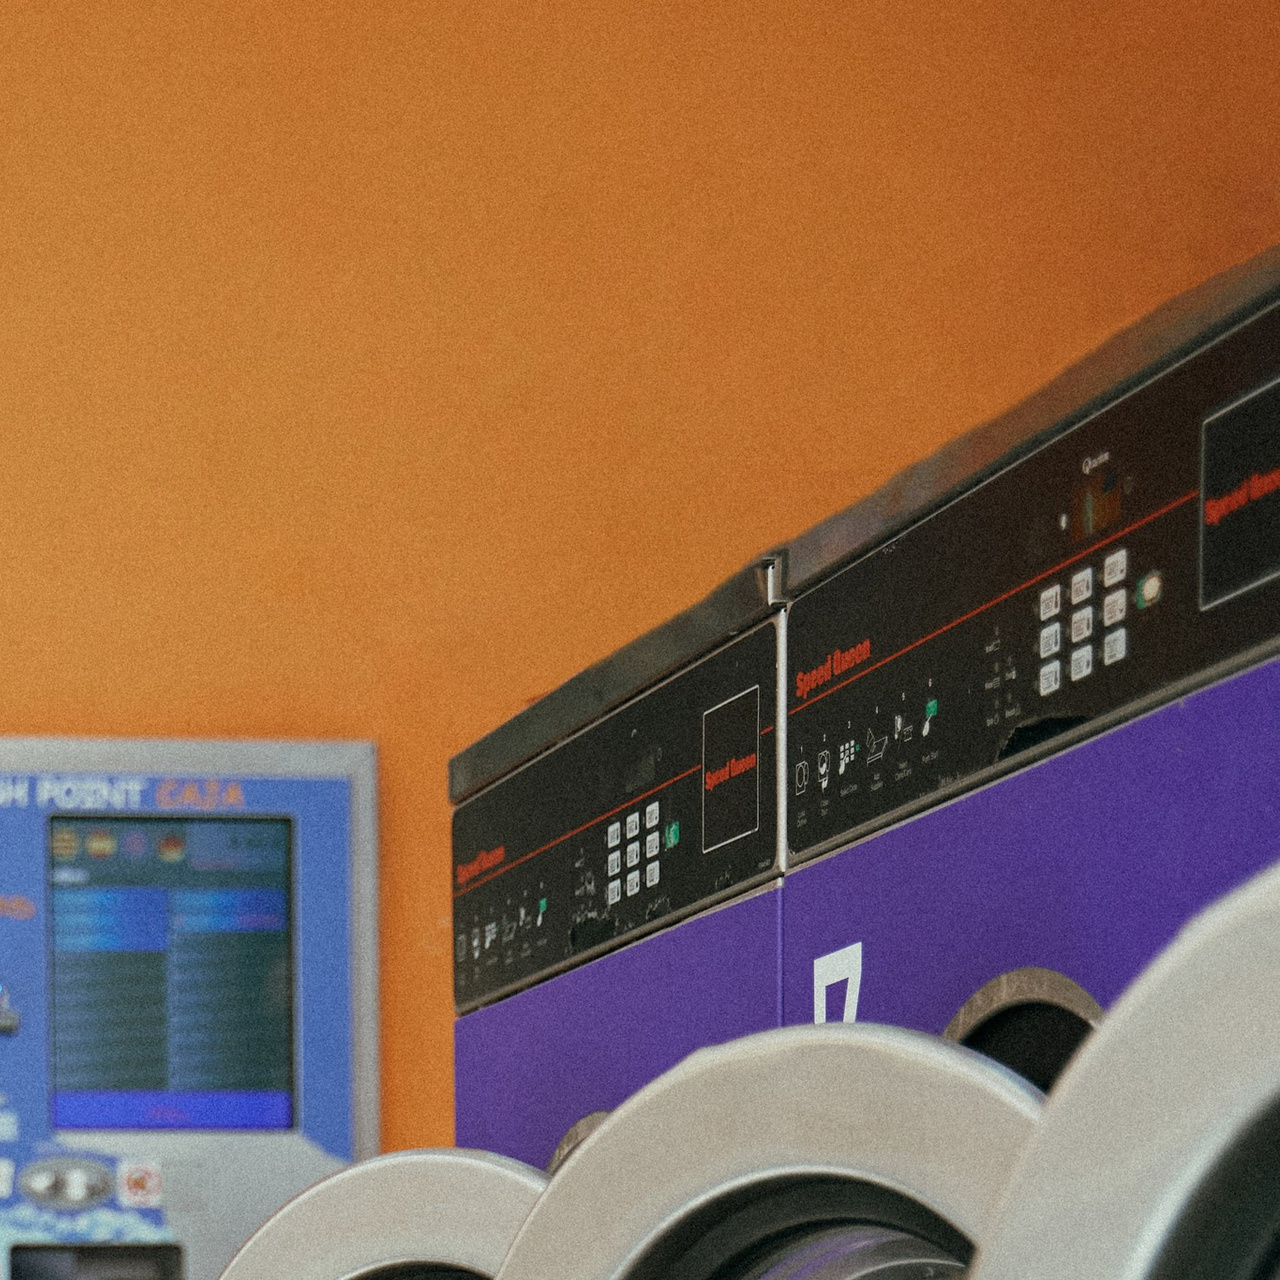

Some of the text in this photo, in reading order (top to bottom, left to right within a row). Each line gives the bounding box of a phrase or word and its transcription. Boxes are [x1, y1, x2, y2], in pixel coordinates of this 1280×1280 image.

[796, 638, 871, 699] Speed Queen
[35, 775, 148, 810] POINT
